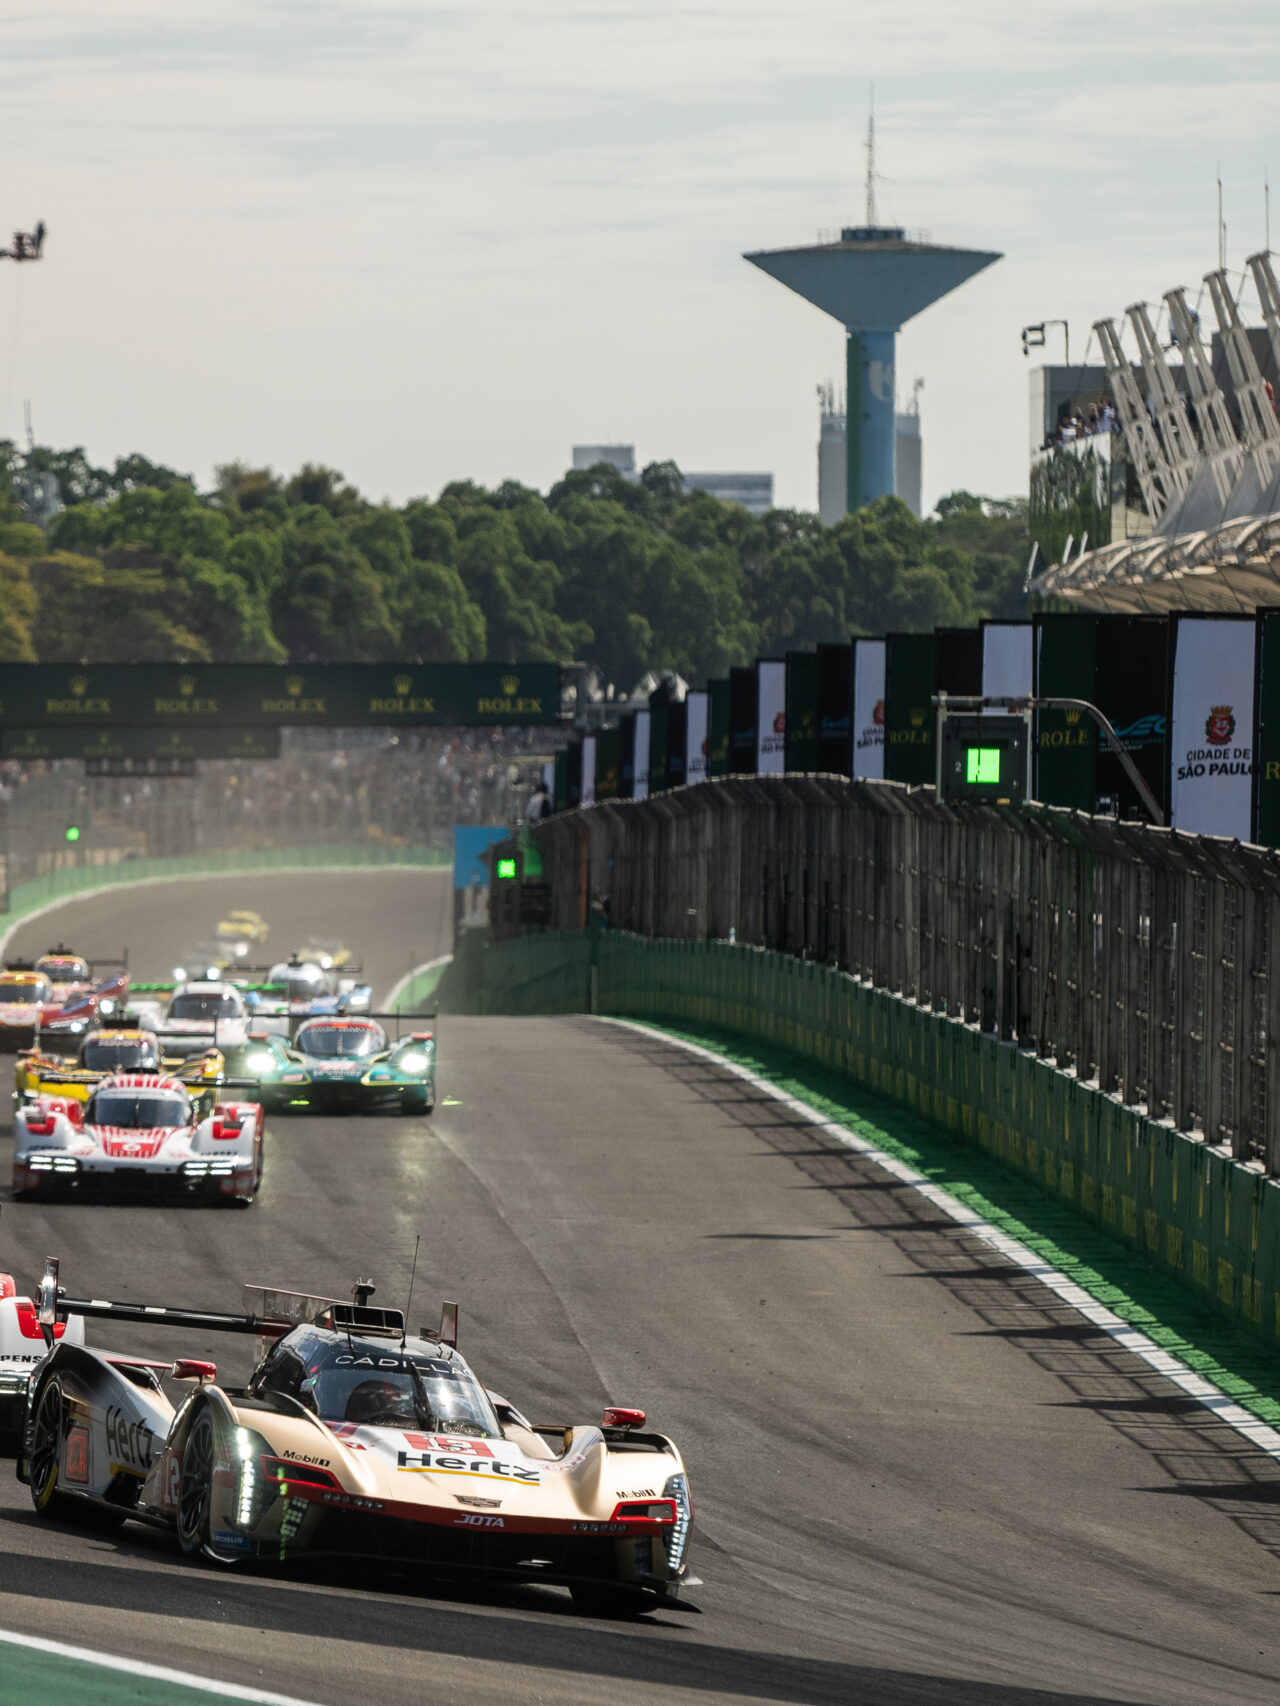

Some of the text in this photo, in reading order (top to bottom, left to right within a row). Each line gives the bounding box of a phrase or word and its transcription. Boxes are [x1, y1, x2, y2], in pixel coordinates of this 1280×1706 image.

[478, 699, 542, 714] ROLEX
[1186, 748, 1251, 761] CIDADE DE
[955, 761, 962, 772] 2
[1177, 762, 1206, 781] SÃO
[334, 1354, 476, 1379] CADILLAC
[106, 1404, 154, 1470] Hertz
[397, 1450, 541, 1482] Hertz
[453, 1513, 505, 1528] JOTA
